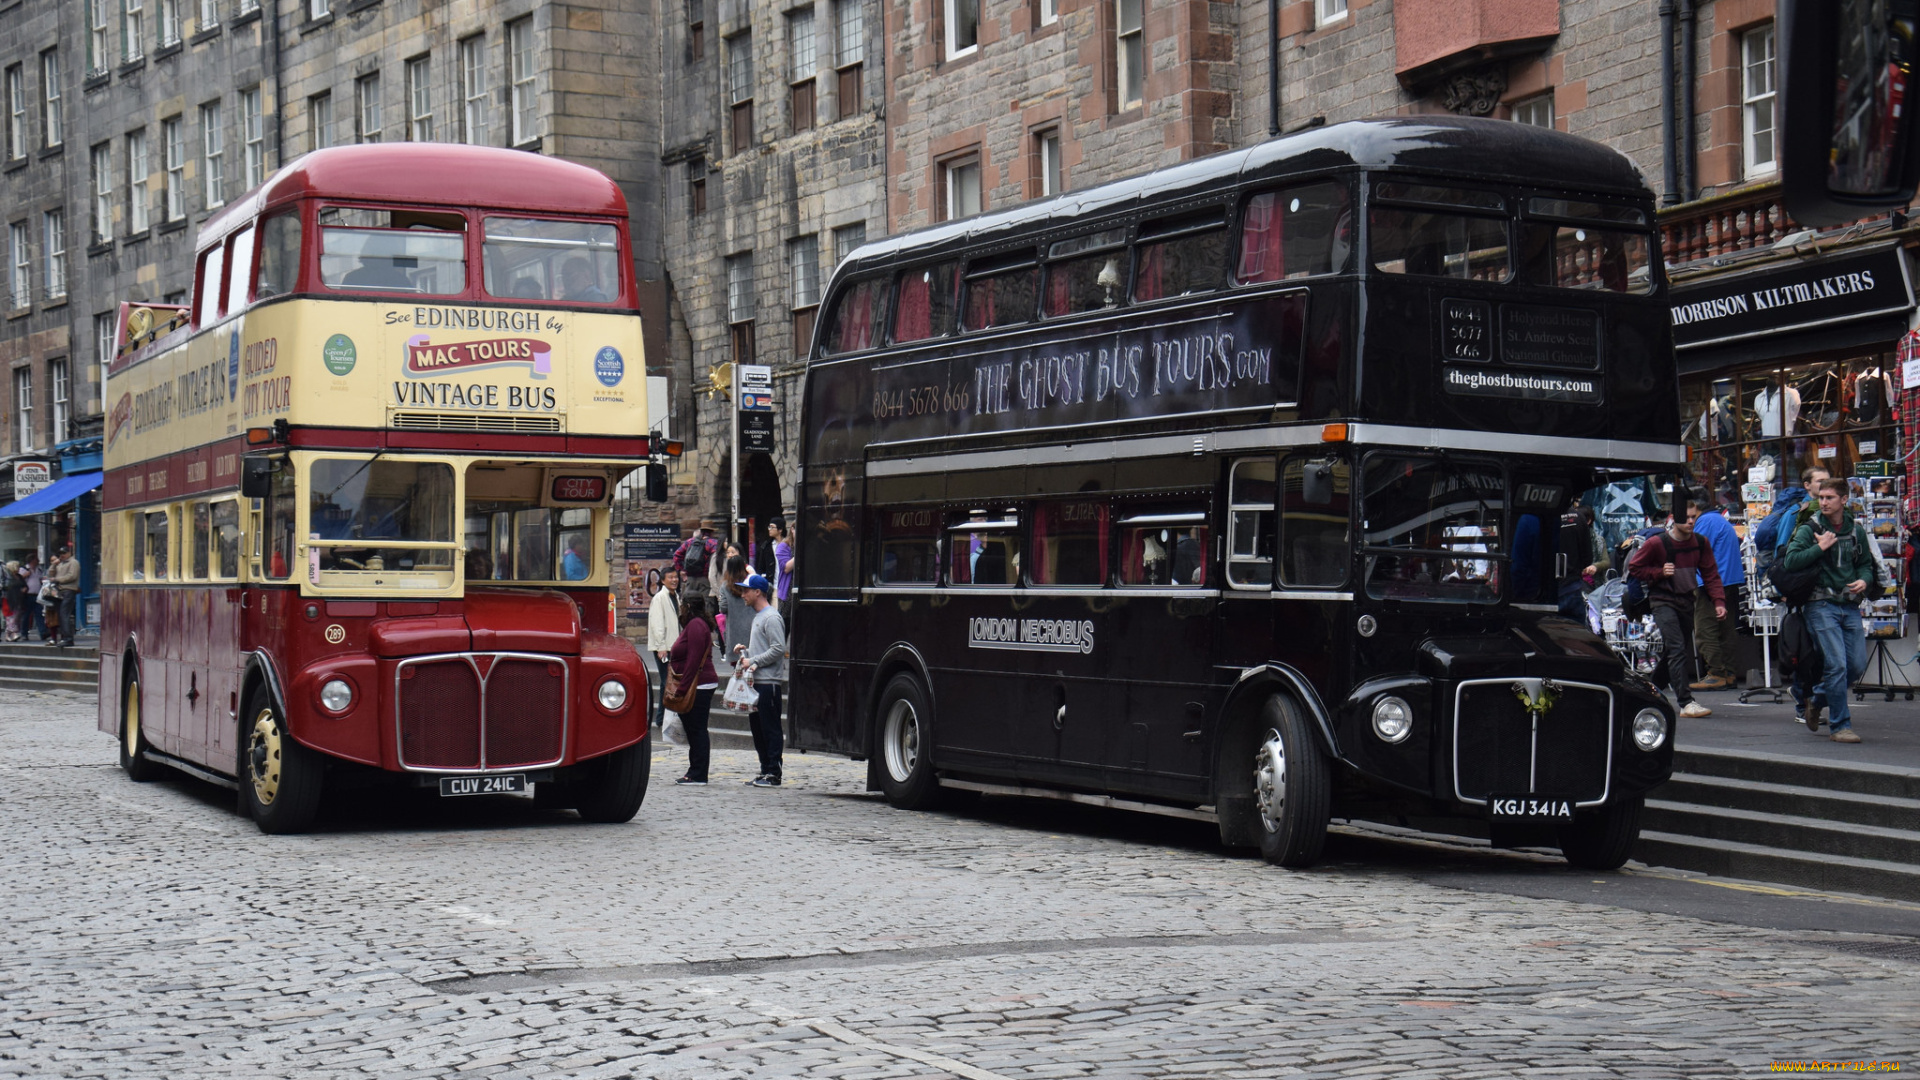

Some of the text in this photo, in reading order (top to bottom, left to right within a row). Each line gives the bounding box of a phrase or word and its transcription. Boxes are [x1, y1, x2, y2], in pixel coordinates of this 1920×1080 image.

[1752, 270, 1876, 311] KILTMAKERS
[385, 307, 564, 334] See EDINBURGH by
[1449, 305, 1482, 321] 0844
[1524, 331, 1566, 344] Andrew
[245, 337, 278, 380] GUIDED
[416, 341, 531, 368] MAC TOURS
[1455, 343, 1480, 358] 666
[209, 357, 226, 407] BUS
[974, 361, 1013, 416] THE
[1019, 352, 1090, 410] GHOST
[1096, 344, 1144, 402] BUS
[1449, 370, 1593, 393] theghostbustours.com
[244, 376, 291, 418] CITY TOUR
[392, 381, 556, 411] VINTAGE BUS
[873, 381, 969, 418] 0844 5678 666
[16, 474, 49, 483] CASHMERE
[567, 478, 593, 488] CITY
[562, 488, 595, 498] TOUR
[1523, 484, 1557, 503] Tour
[328, 628, 342, 640] 289
[968, 617, 1094, 654] LONDON NECROBUS
[451, 777, 515, 793] CUV 241C
[1492, 799, 1571, 817] KGJ 341A
